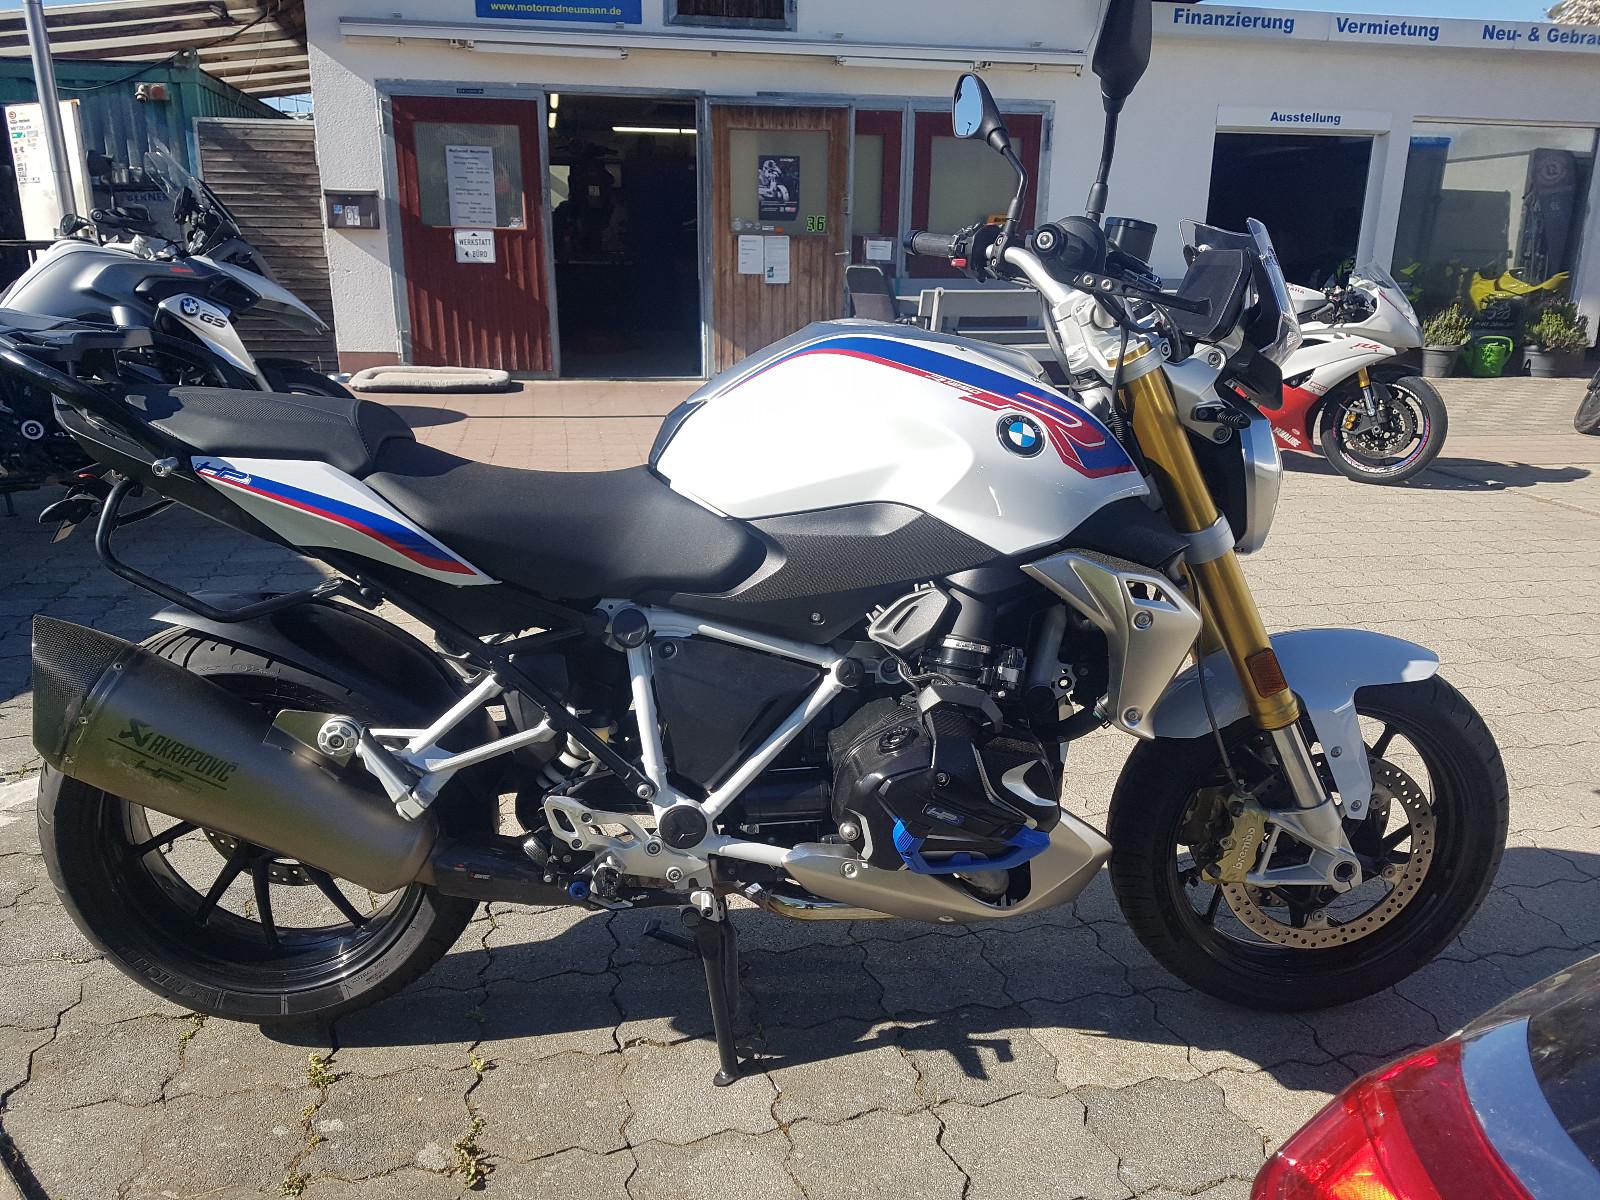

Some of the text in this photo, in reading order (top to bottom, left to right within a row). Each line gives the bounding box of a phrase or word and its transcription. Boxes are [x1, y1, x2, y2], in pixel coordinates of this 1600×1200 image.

[490, 2, 622, 16] www.motorradneumann.de
[1173, 7, 1295, 34] Finanzierung
[1335, 16, 1440, 42] Vermietung
[1482, 24, 1521, 41] Neu-
[1527, 26, 1540, 42] &
[1270, 111, 1342, 126] Ausstellung
[806, 215, 826, 232] 36
[459, 238, 491, 246] WERKSTATT
[199, 312, 228, 329] GS
[1004, 415, 1042, 433] BMW
[1232, 827, 1257, 870] brembo
